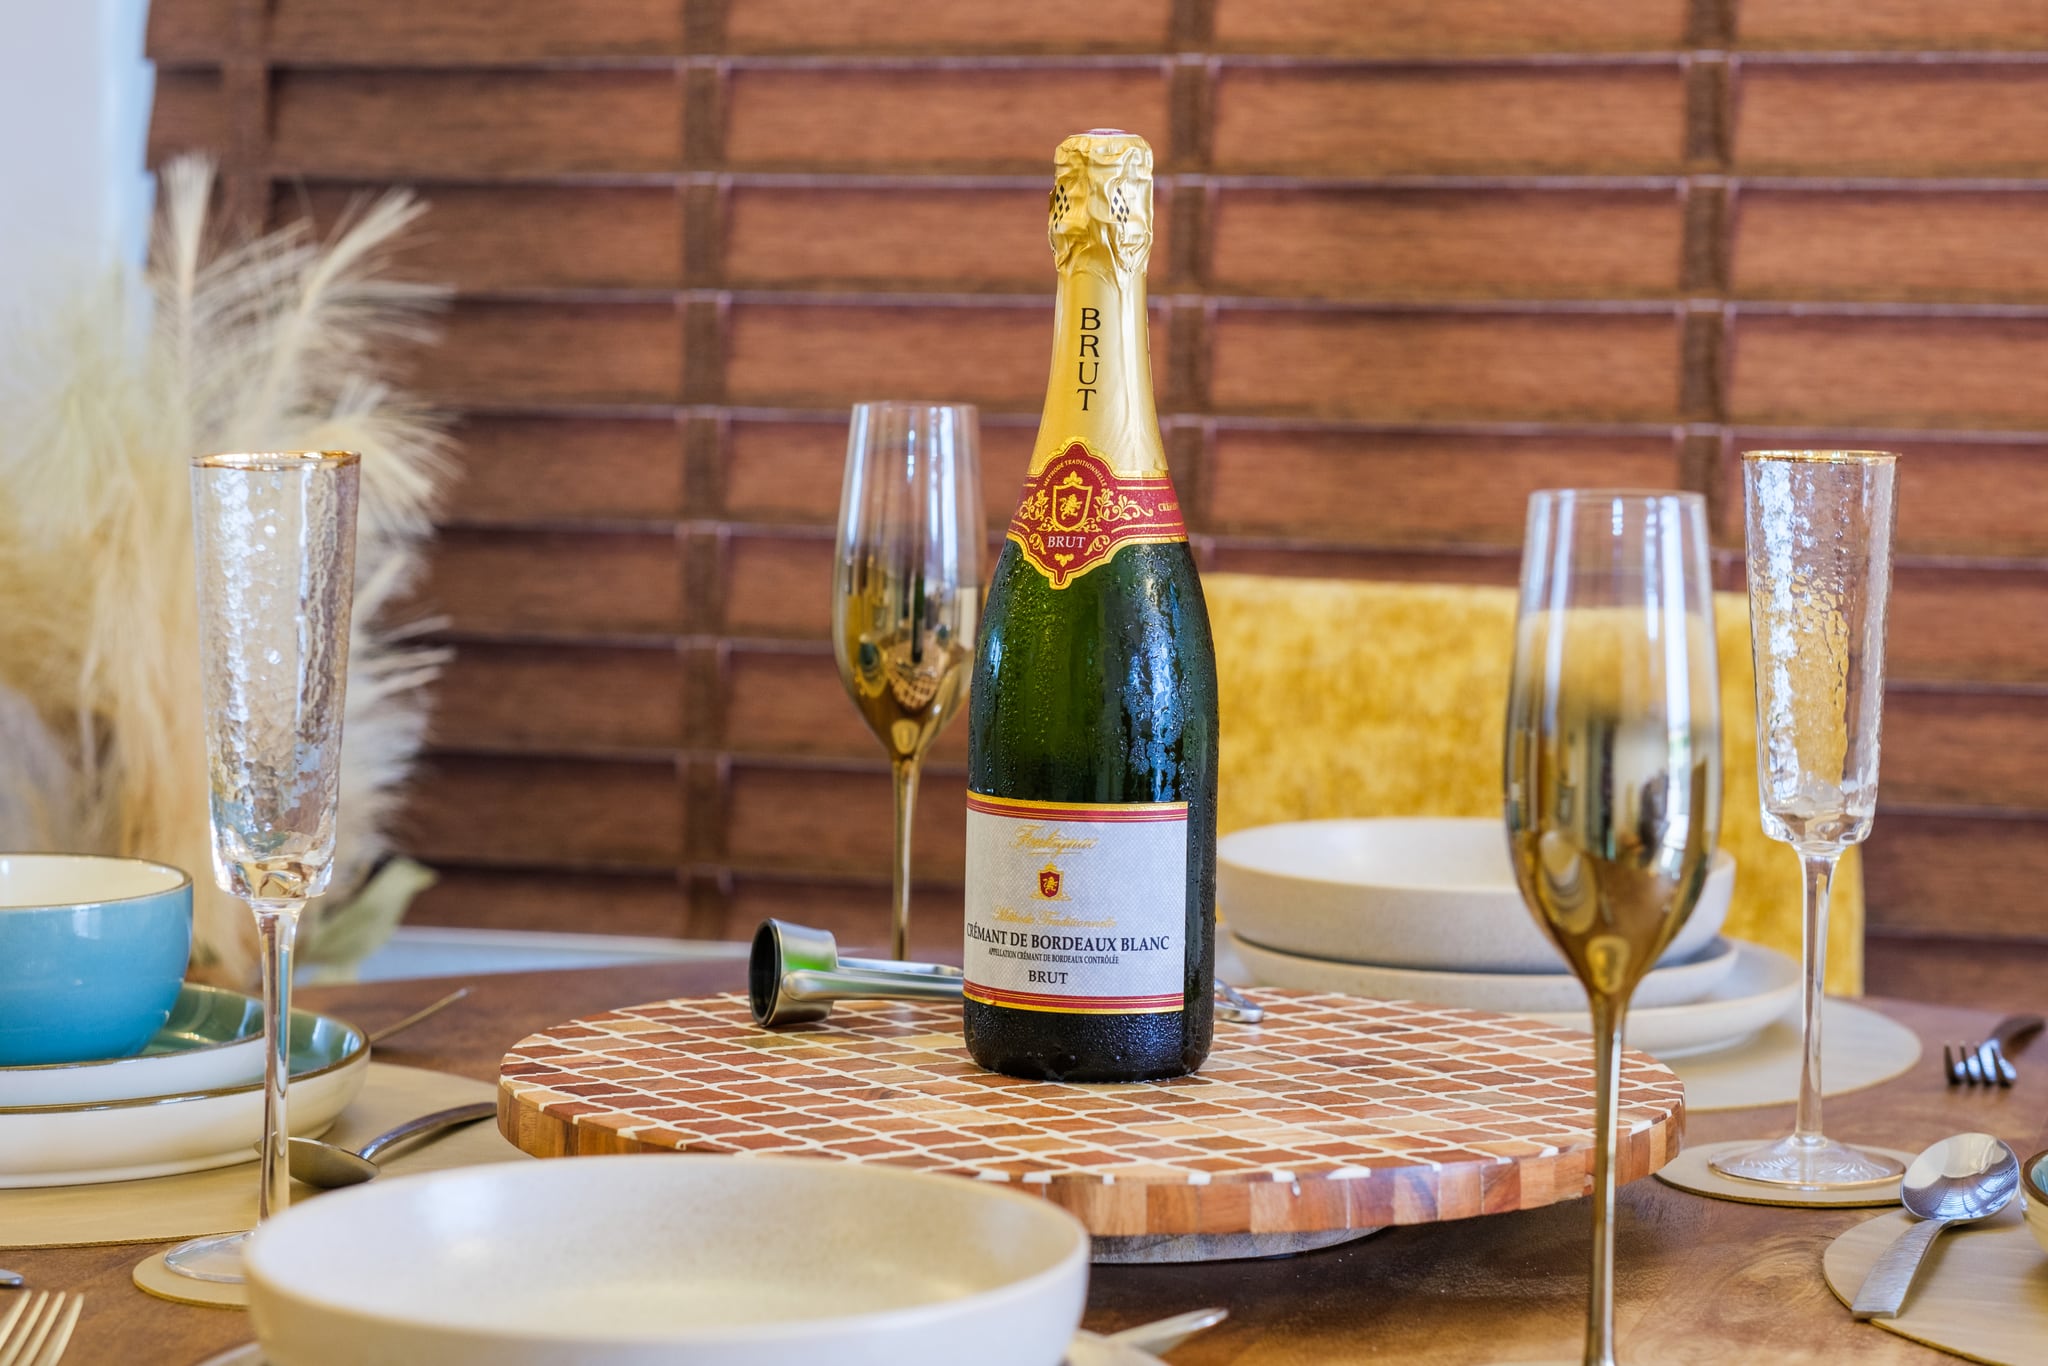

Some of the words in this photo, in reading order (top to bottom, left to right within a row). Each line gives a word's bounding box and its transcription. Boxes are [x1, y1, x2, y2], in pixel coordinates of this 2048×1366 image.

[1078, 308, 1101, 411] BRUT
[1065, 459, 1108, 488] TRADITIONNELLE
[1047, 536, 1086, 549] BRUT
[966, 922, 1008, 946] CRÉMANT
[1011, 932, 1028, 947] DE
[1031, 934, 1117, 952] BORDEAUX
[1121, 935, 1170, 952] BLANC
[988, 948, 1016, 959] APPELLATION
[1016, 951, 1042, 961] CRÉMANT
[1043, 954, 1051, 962] DE
[1052, 954, 1083, 964] BORDEAUX
[1084, 955, 1119, 965] CONTRÔLÉE
[1028, 970, 1068, 984] BRUT
